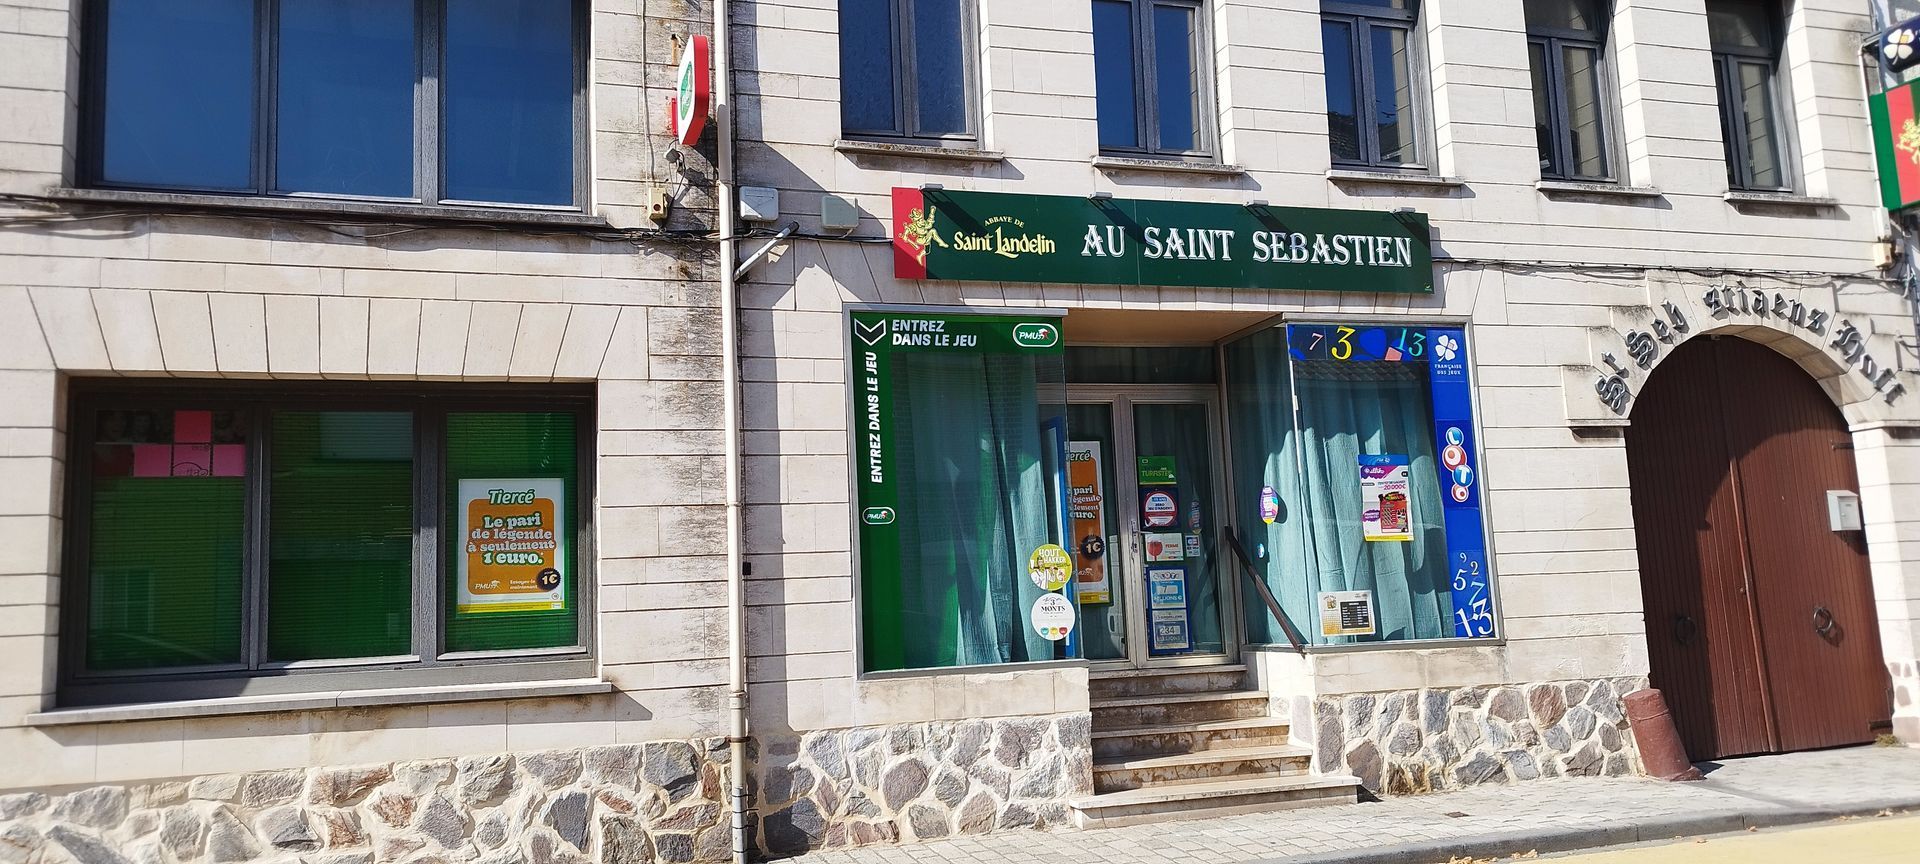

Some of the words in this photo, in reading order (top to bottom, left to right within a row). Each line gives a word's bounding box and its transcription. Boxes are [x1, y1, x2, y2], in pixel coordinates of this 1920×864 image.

[985, 216, 1012, 226] ABBAYE
[1014, 219, 1025, 228] DE
[954, 231, 993, 251] Saint
[995, 226, 1056, 259] Landelin
[1081, 225, 1125, 258] AU
[1144, 227, 1234, 261] SAINT
[1252, 231, 1412, 268] SEBASTIEN
[892, 319, 945, 332] ENTREZ
[892, 333, 931, 346] DANS
[934, 334, 950, 346] LE
[952, 334, 977, 347] JEU
[1019, 331, 1039, 340] PMU
[1309, 332, 1324, 350] 7
[1331, 325, 1356, 360] 3
[865, 352, 877, 375] JEU
[867, 376, 878, 392] LE
[867, 394, 880, 431] DANS
[869, 433, 882, 483] ENTREZ
[489, 489, 535, 504] Tiercé
[1073, 485, 1093, 495] pari
[484, 516, 503, 528] Le
[507, 512, 541, 529] pari
[472, 528, 489, 539] de
[494, 528, 552, 540] légende
[468, 541, 476, 552] à
[480, 540, 555, 552] seulement
[484, 552, 492, 563] 1
[1459, 552, 1467, 563] 9
[1470, 561, 1480, 576] 2
[1453, 568, 1468, 591] 5
[1468, 581, 1485, 606] 7
